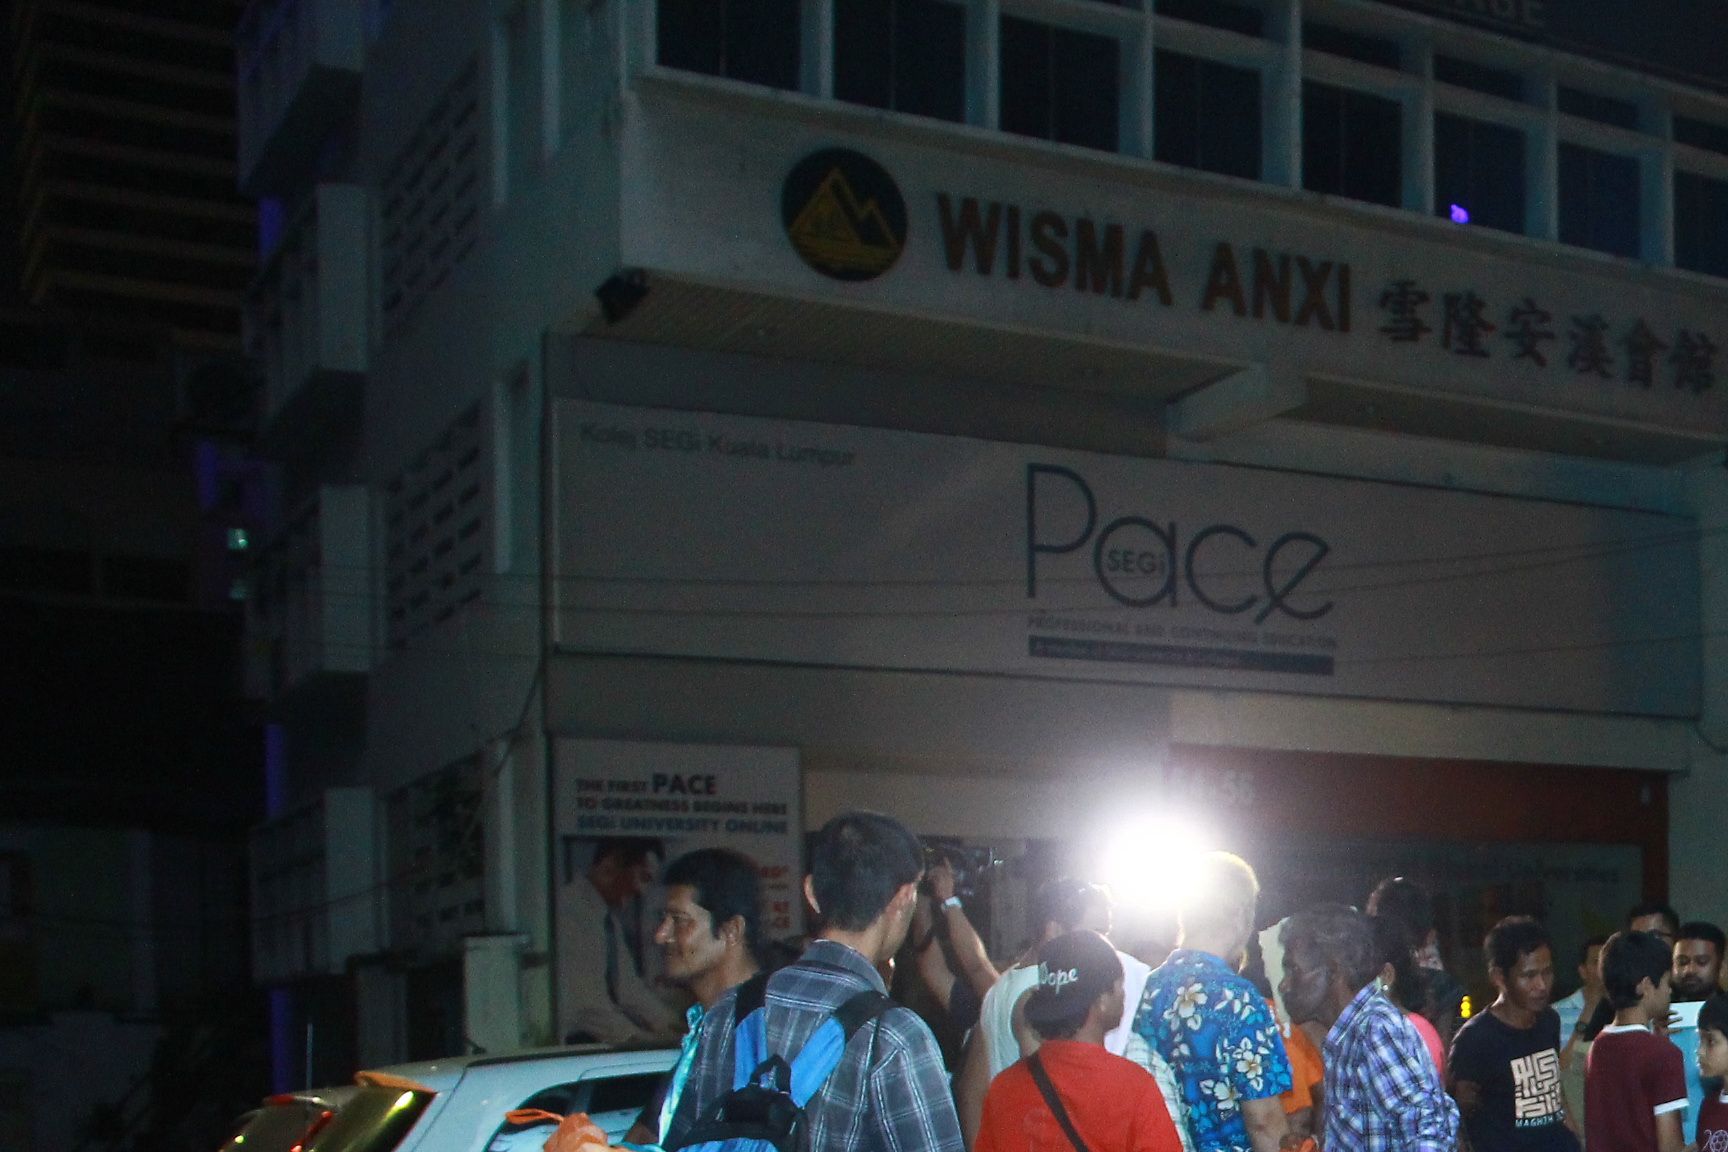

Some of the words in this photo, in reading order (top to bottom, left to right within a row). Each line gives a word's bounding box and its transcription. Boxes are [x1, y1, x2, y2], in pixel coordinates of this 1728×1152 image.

[936, 192, 1173, 306] WISMA
[1201, 240, 1352, 333] ANXI
[1027, 463, 1335, 624] Pace
[652, 772, 717, 795] PACE
[620, 816, 720, 832] UNIVERSITY
[724, 818, 788, 834] ONLINE
